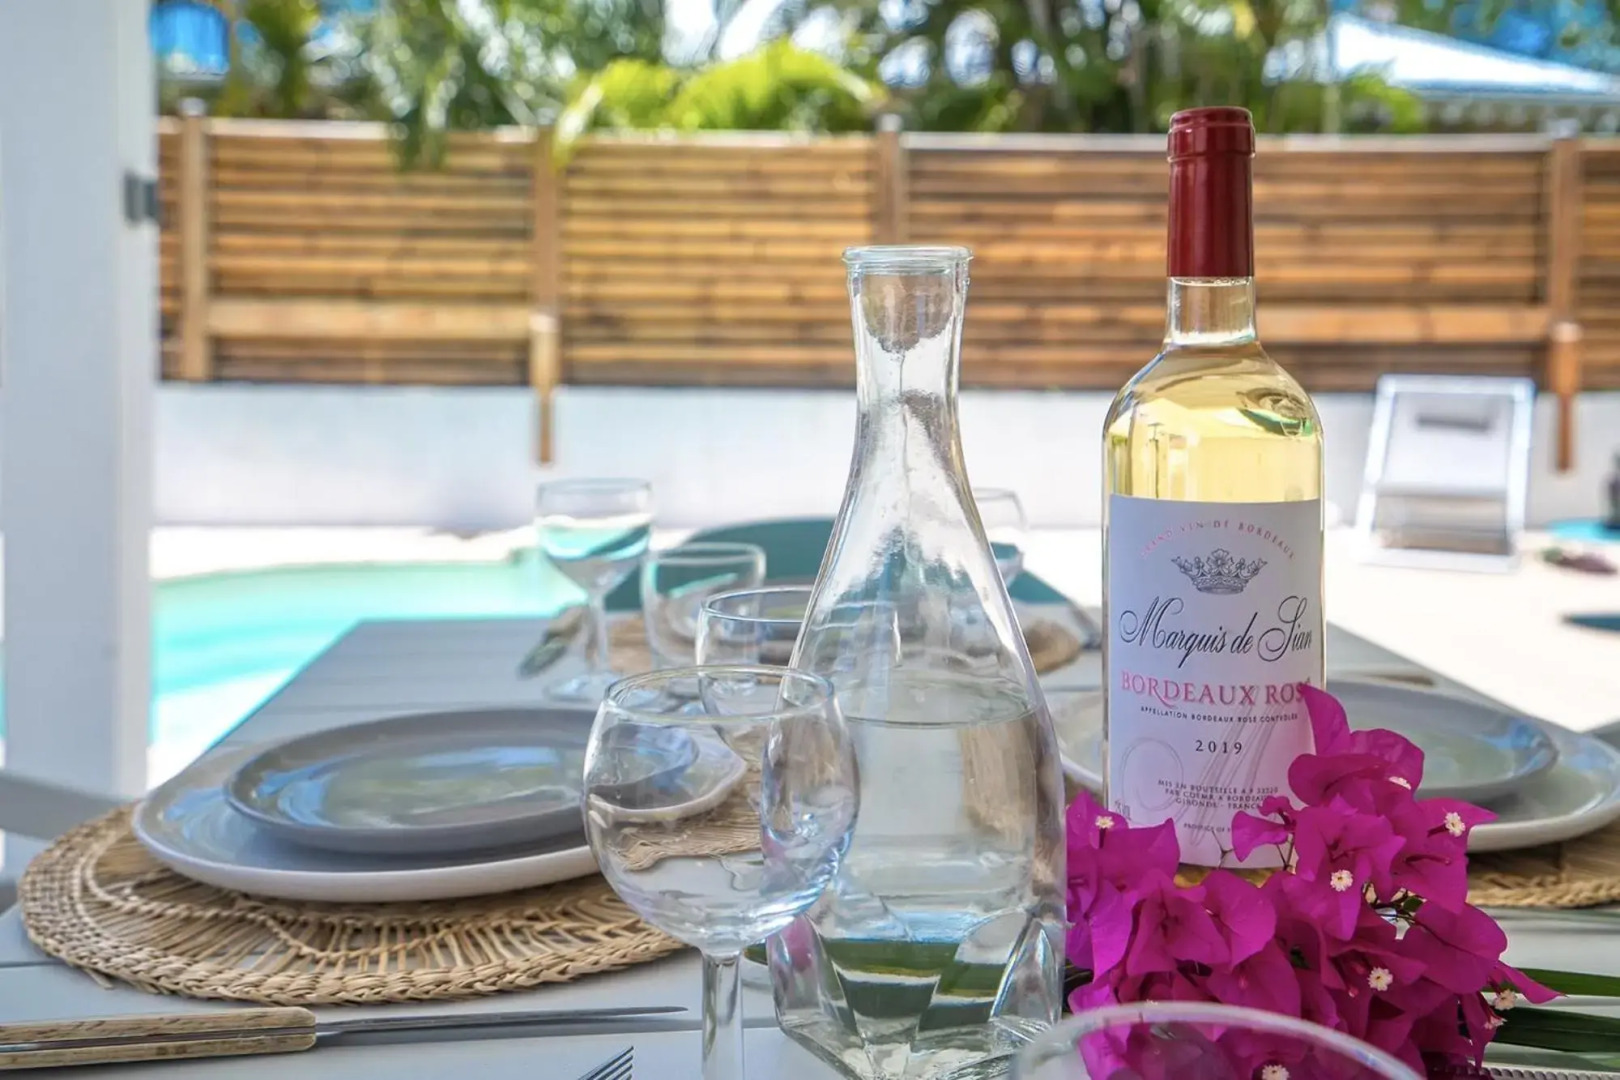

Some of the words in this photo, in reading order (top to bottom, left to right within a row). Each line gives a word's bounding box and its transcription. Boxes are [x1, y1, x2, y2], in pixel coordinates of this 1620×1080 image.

[1213, 519, 1229, 529] DE
[1238, 521, 1296, 561] BORDEAUX
[1119, 595, 1226, 669] Marquis
[1230, 611, 1258, 655] de
[1121, 670, 1256, 709] BORDEAUX
[1265, 676, 1310, 705] ROS
[1140, 705, 1187, 719] APPELLATION
[1191, 713, 1234, 723] BORDEAUX
[1195, 739, 1243, 754] 2019
[1158, 779, 1173, 787] MIS
[1176, 781, 1187, 789] EN
[1175, 797, 1217, 808] GIRONDE
